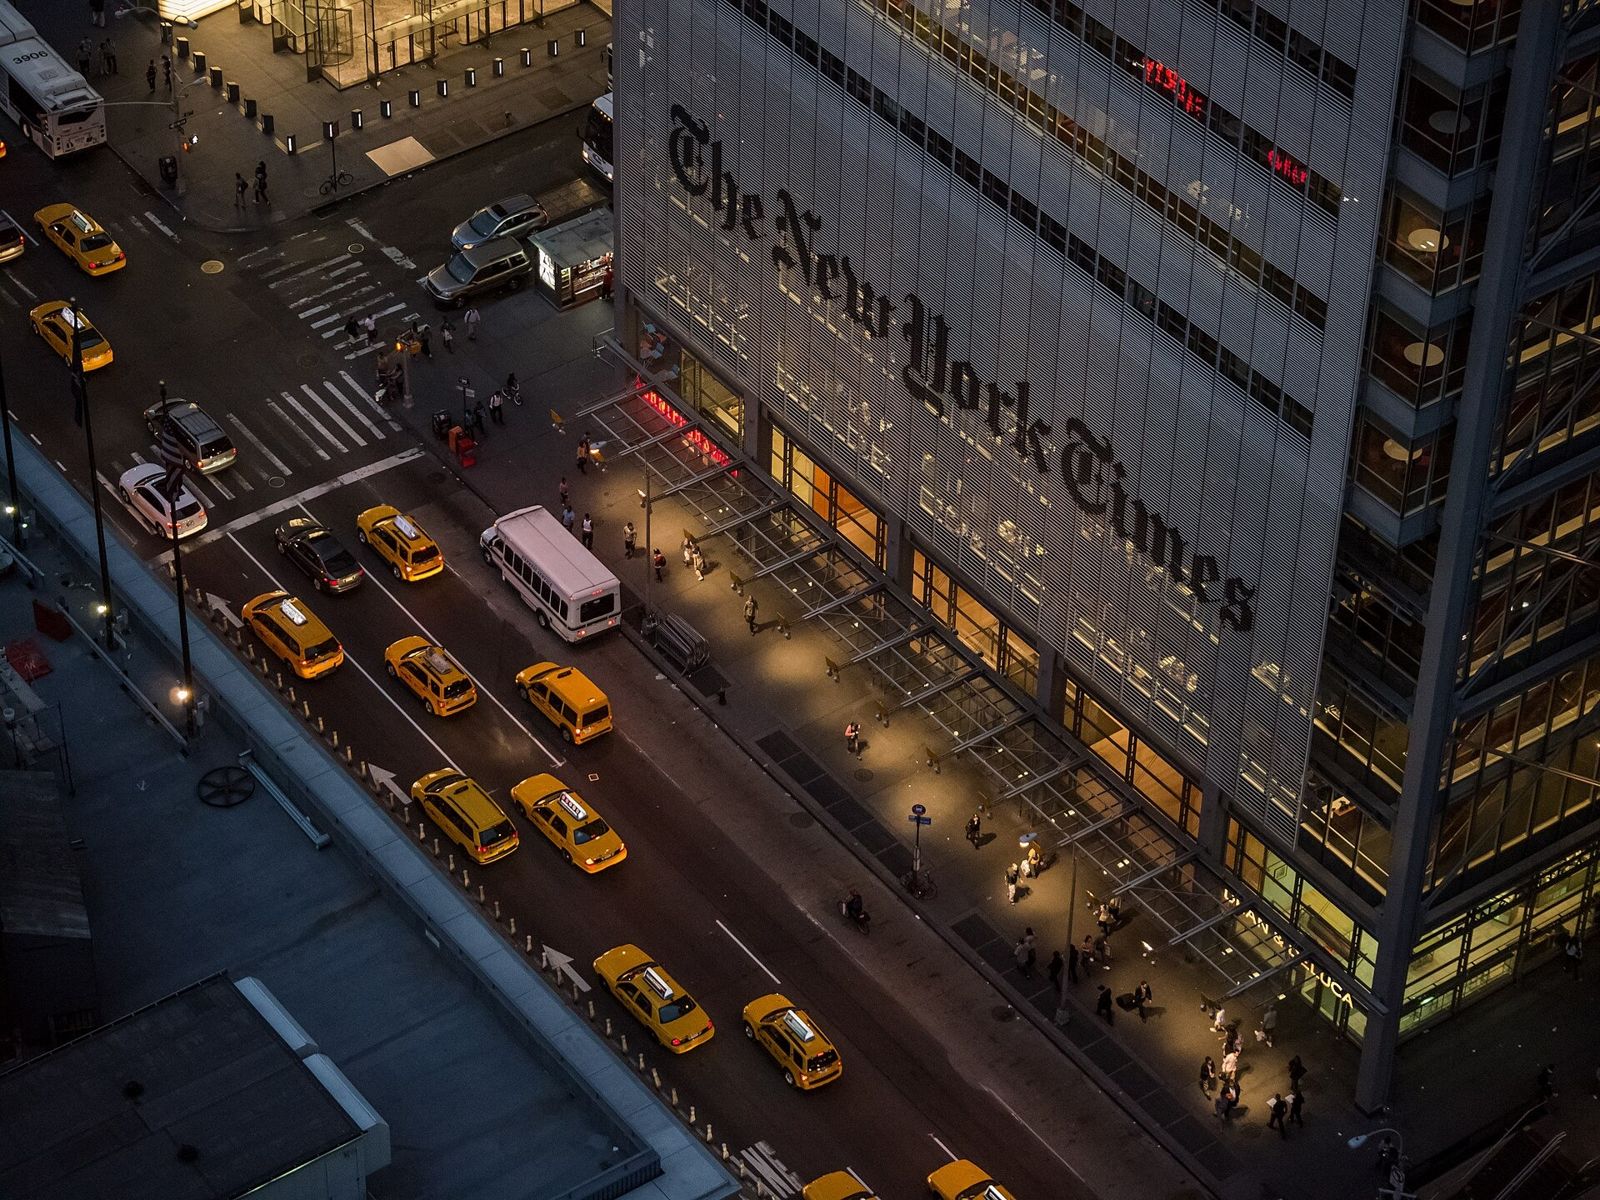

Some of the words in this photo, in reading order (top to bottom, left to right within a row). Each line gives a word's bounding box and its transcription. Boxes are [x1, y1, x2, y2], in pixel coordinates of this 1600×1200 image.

[12, 50, 49, 65] 3906
[668, 103, 766, 240] The
[771, 188, 897, 338] New
[902, 293, 1051, 474] York
[1060, 416, 1257, 632] Times
